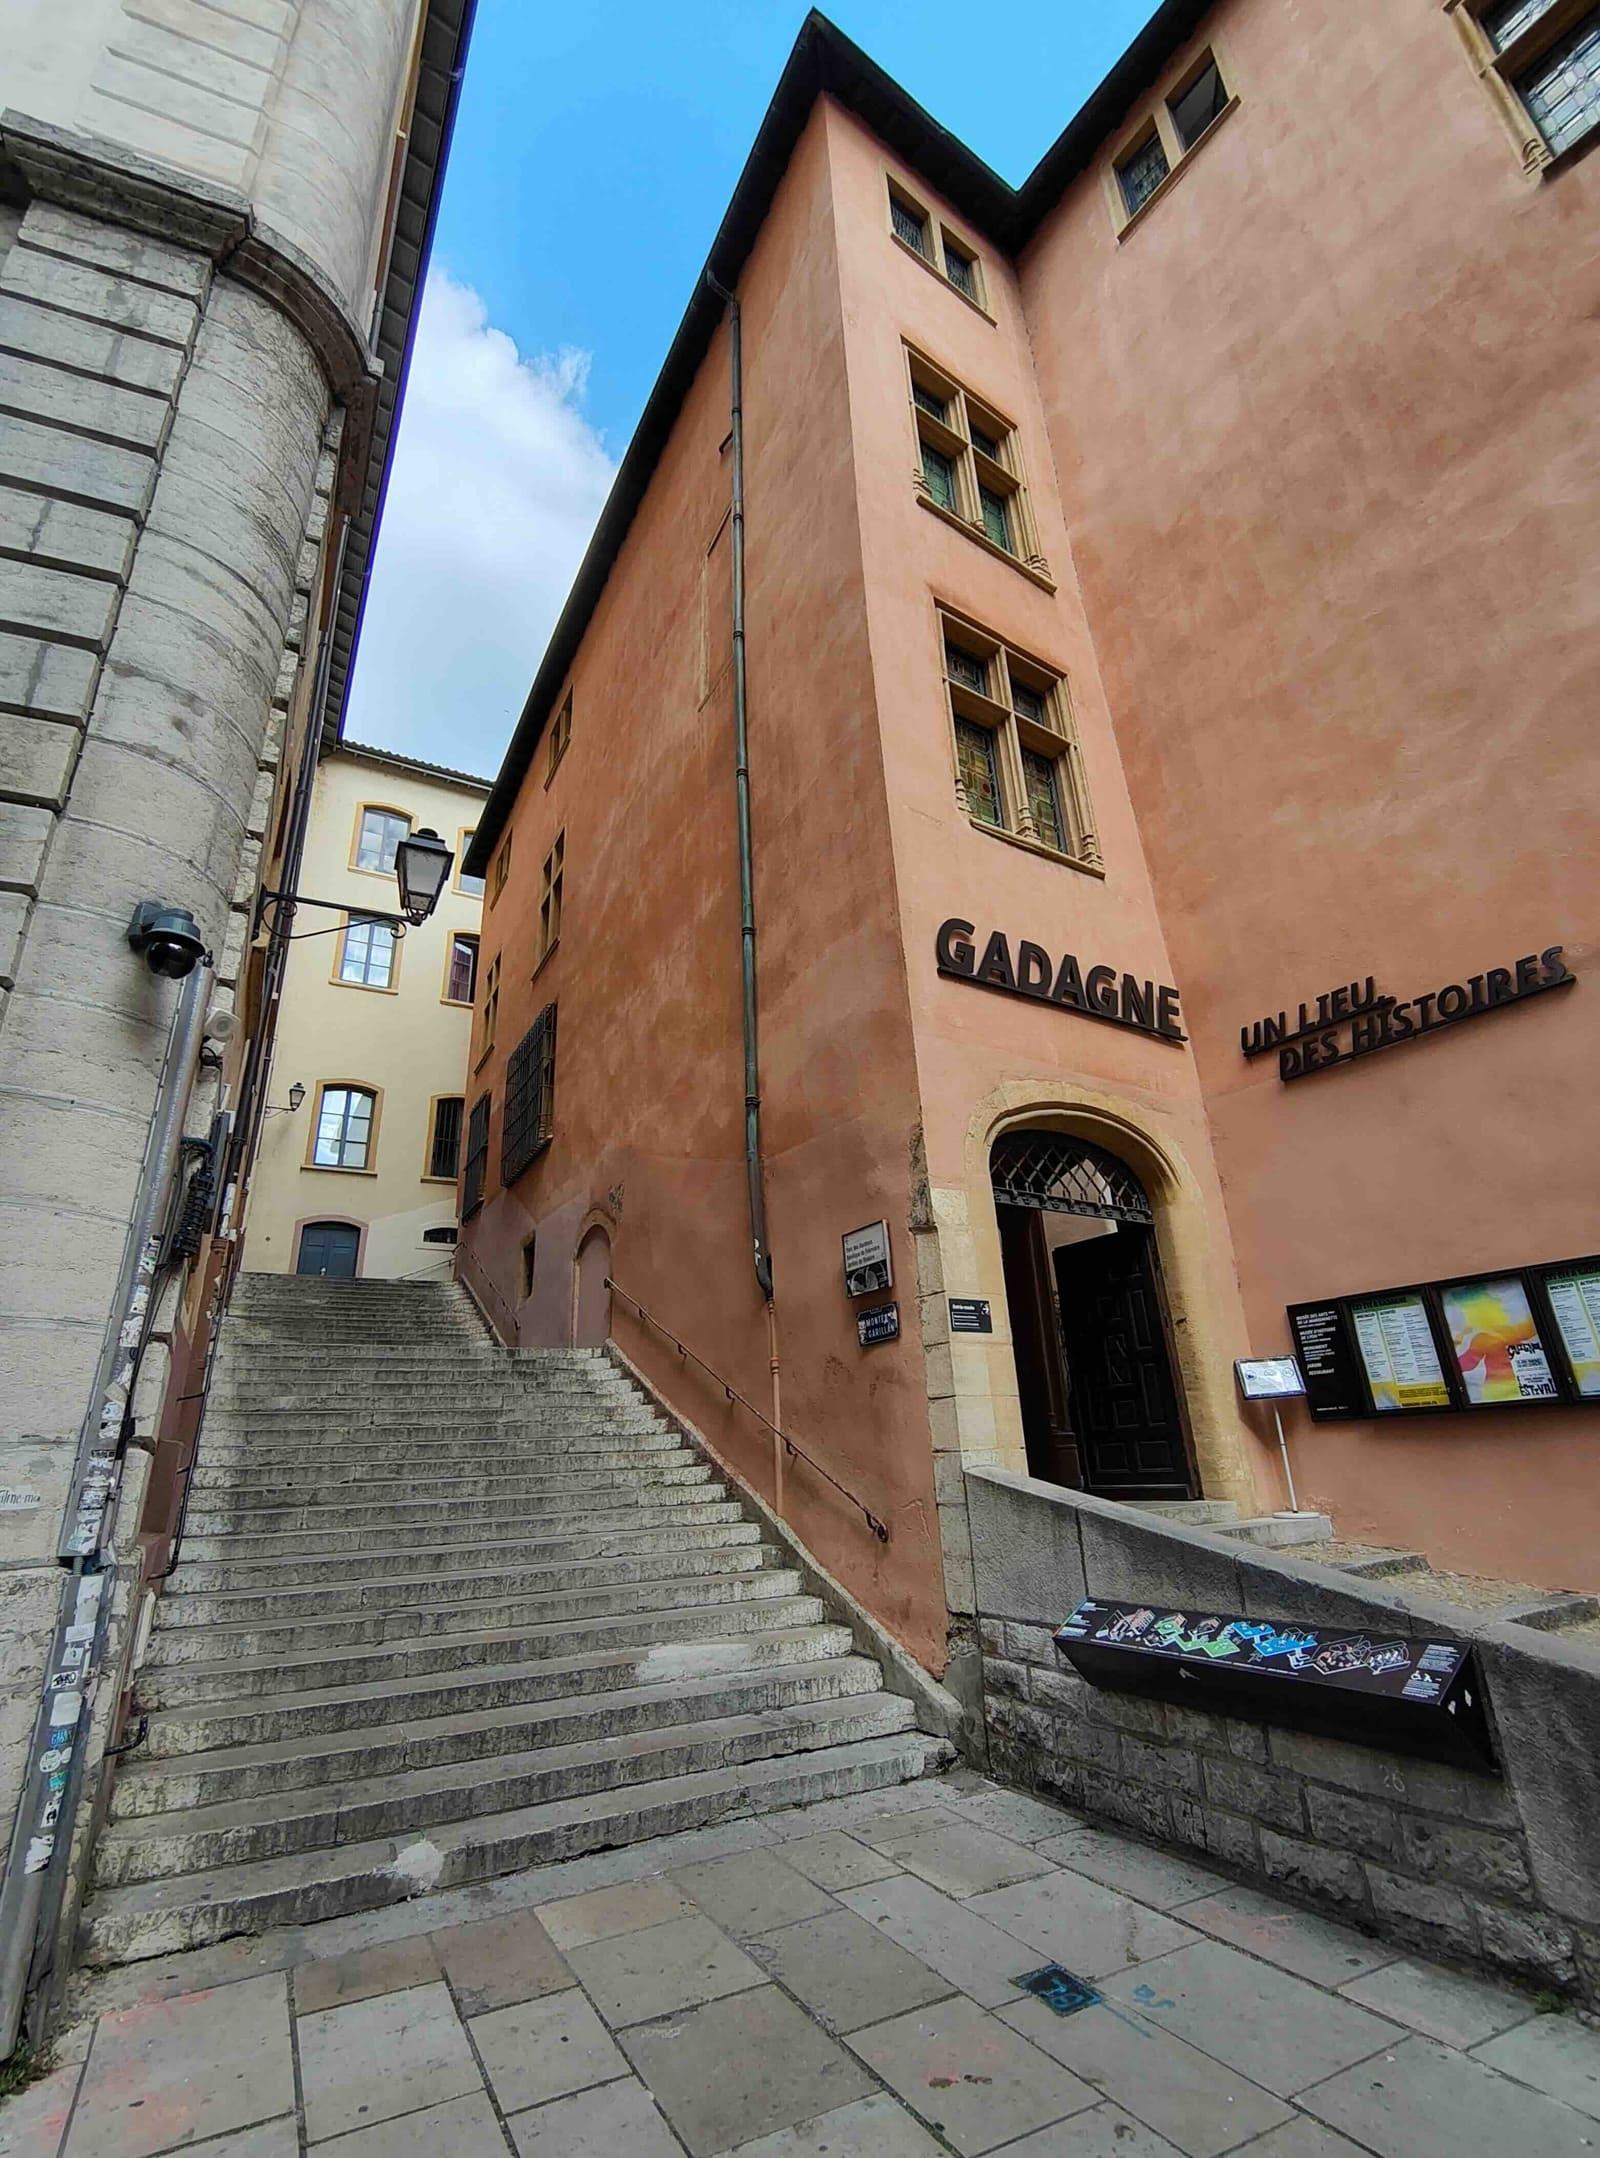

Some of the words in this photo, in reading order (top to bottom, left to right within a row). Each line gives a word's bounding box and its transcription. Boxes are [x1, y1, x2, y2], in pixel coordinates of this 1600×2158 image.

[936, 918, 1180, 1037] GADAGNE
[1241, 1011, 1286, 1052] UN
[1280, 1031, 1340, 1079] DES
[1352, 946, 1568, 1053] HISTOIRES
